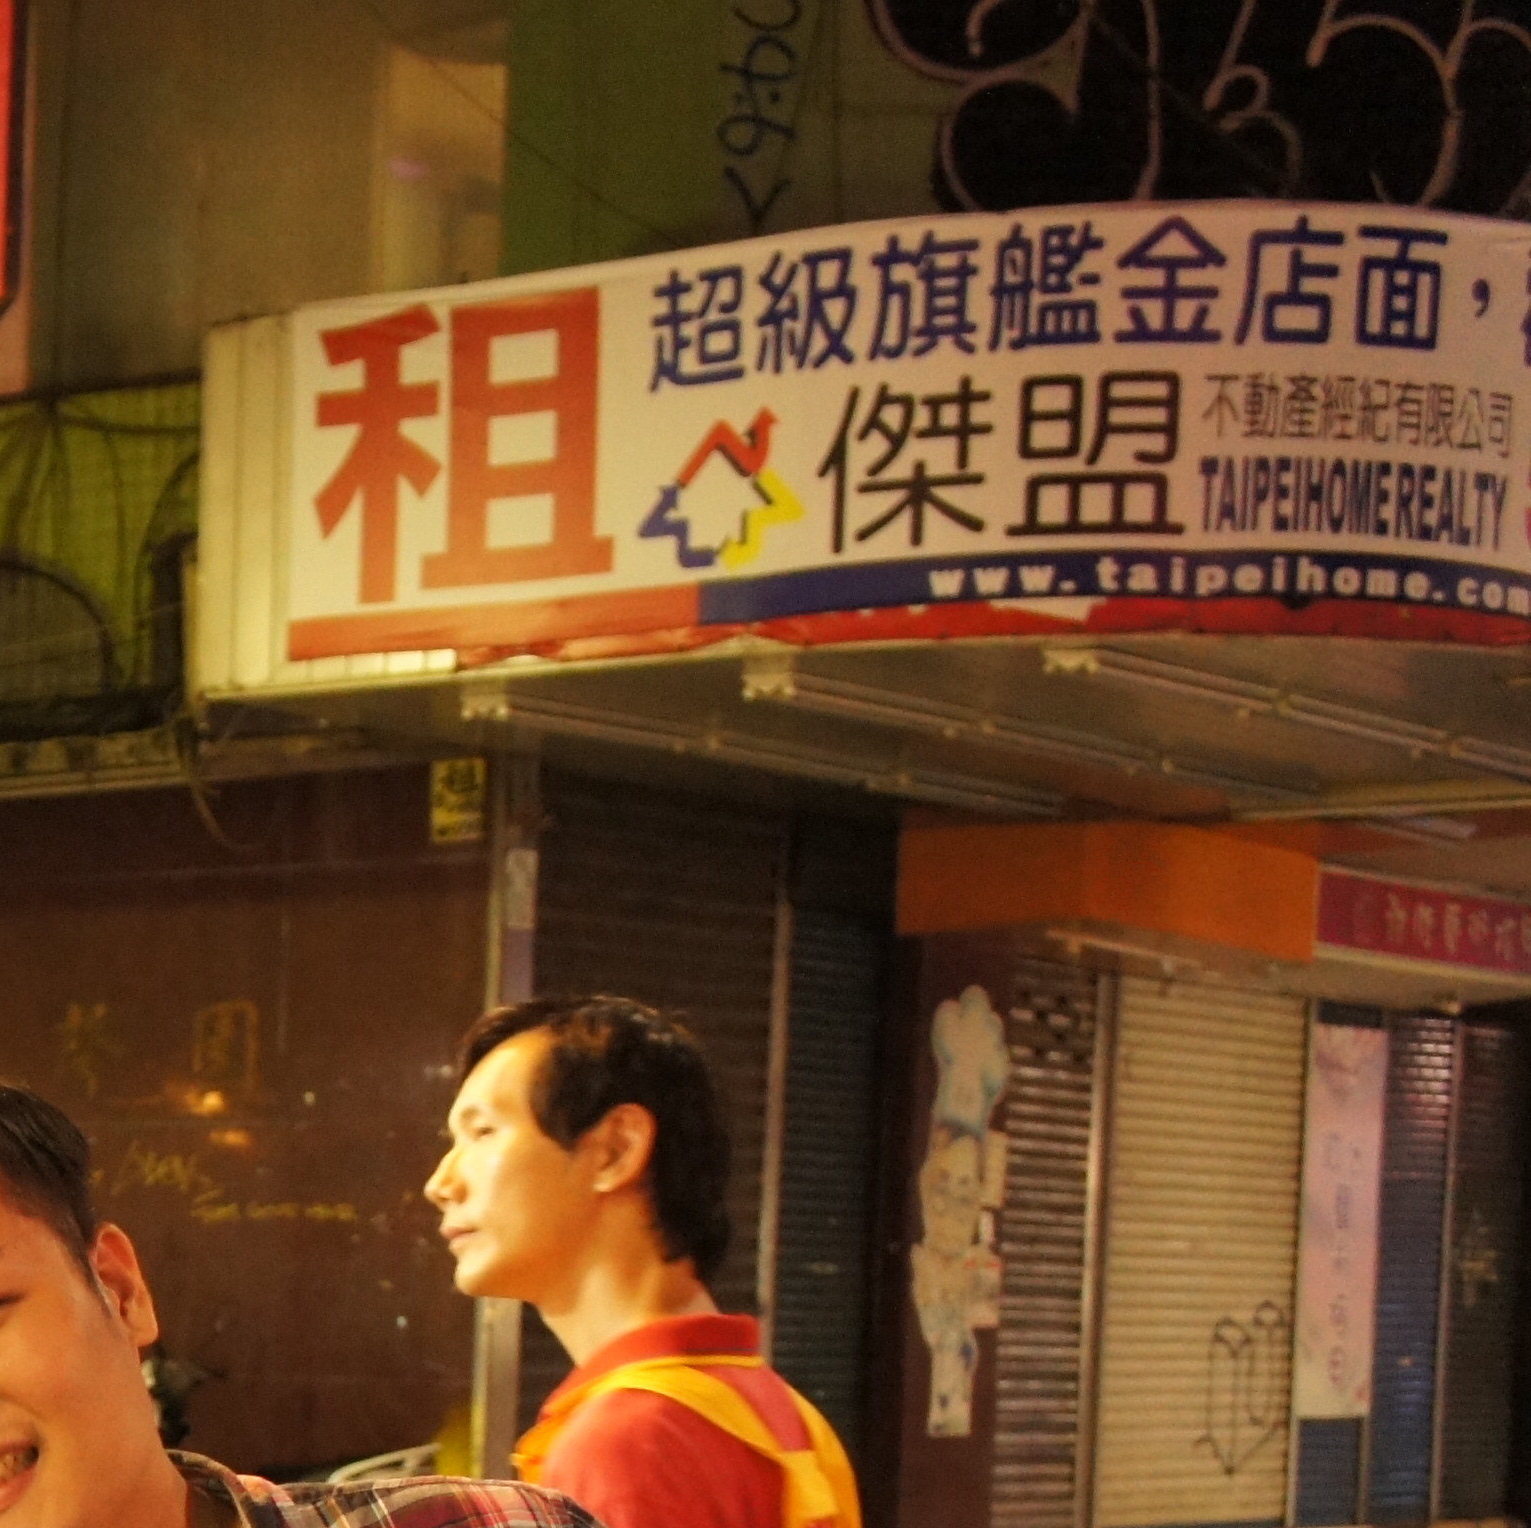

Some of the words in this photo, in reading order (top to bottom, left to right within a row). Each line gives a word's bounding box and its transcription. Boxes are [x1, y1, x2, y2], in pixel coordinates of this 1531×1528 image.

[648, 216, 1531, 392] 超級旗艦金店面，
[314, 286, 615, 604] 租
[818, 371, 1185, 552] 傑盟
[1201, 373, 1513, 458] 不動產經紀有限公司
